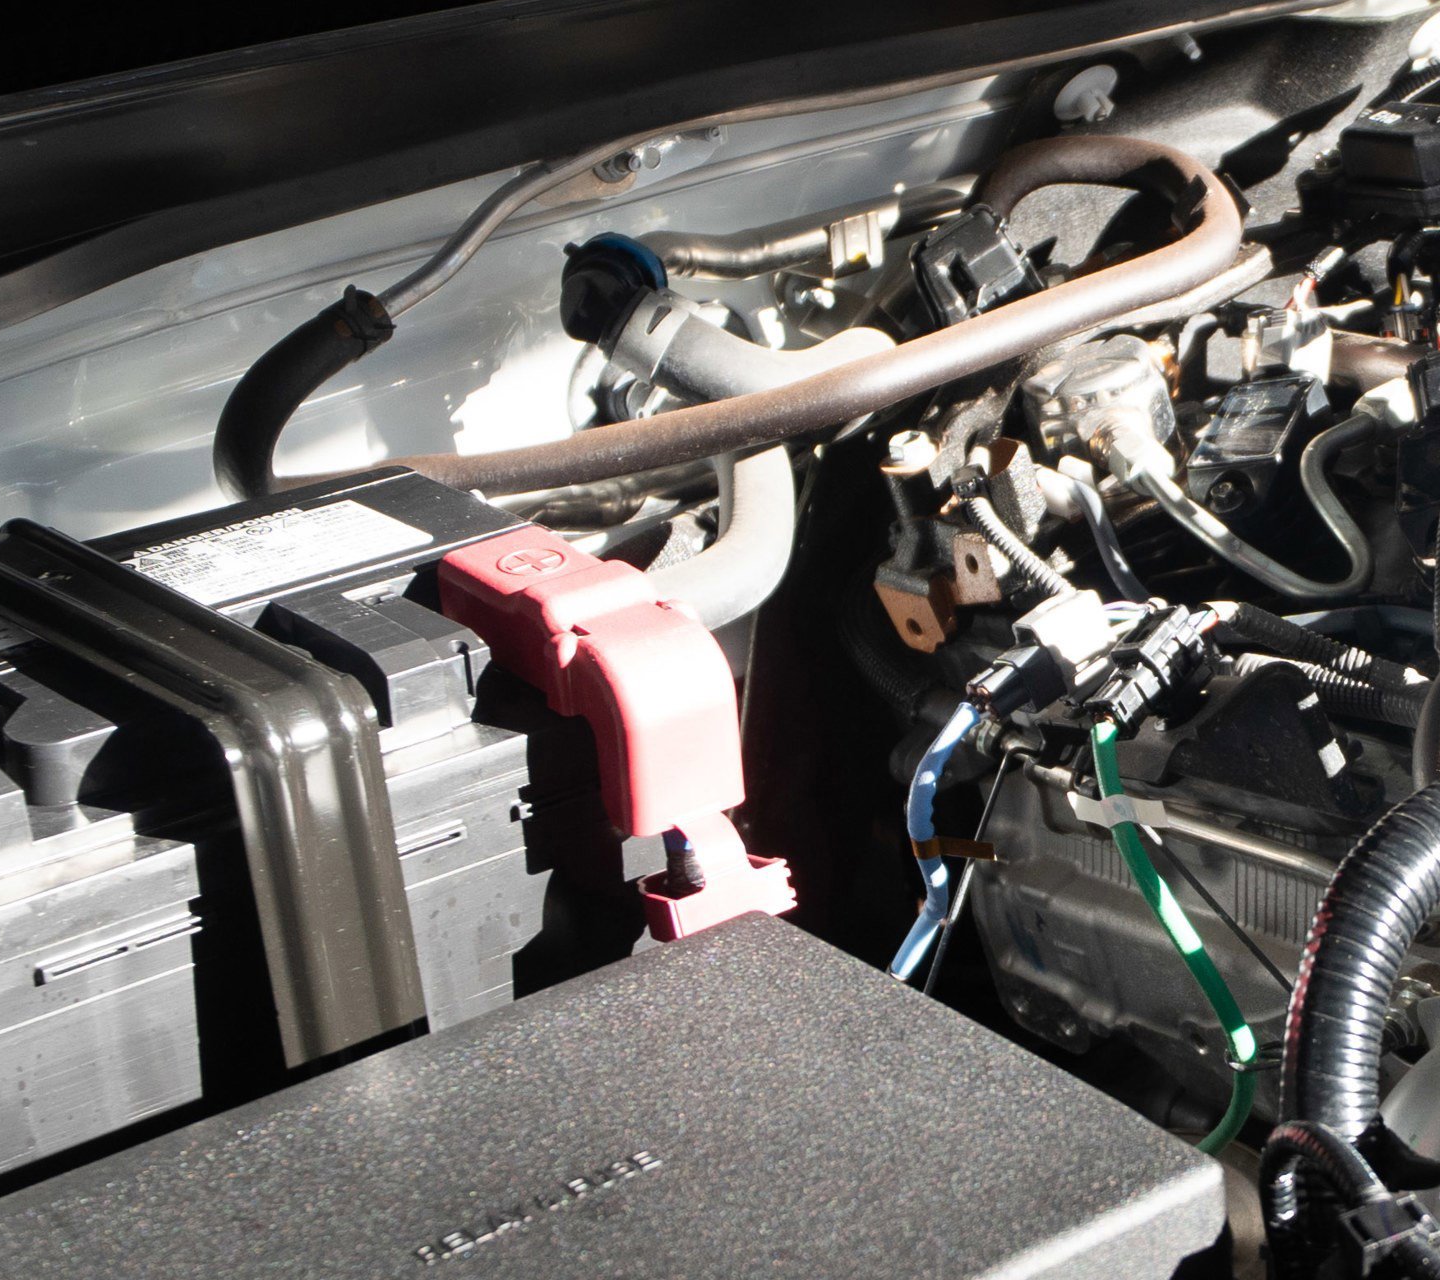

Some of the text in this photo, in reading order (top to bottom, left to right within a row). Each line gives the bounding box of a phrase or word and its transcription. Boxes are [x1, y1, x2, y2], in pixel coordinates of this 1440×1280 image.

[145, 507, 305, 554] DANGER/POISON
[414, 1205, 532, 1267] RELAY
[566, 1150, 664, 1200] FUSE
